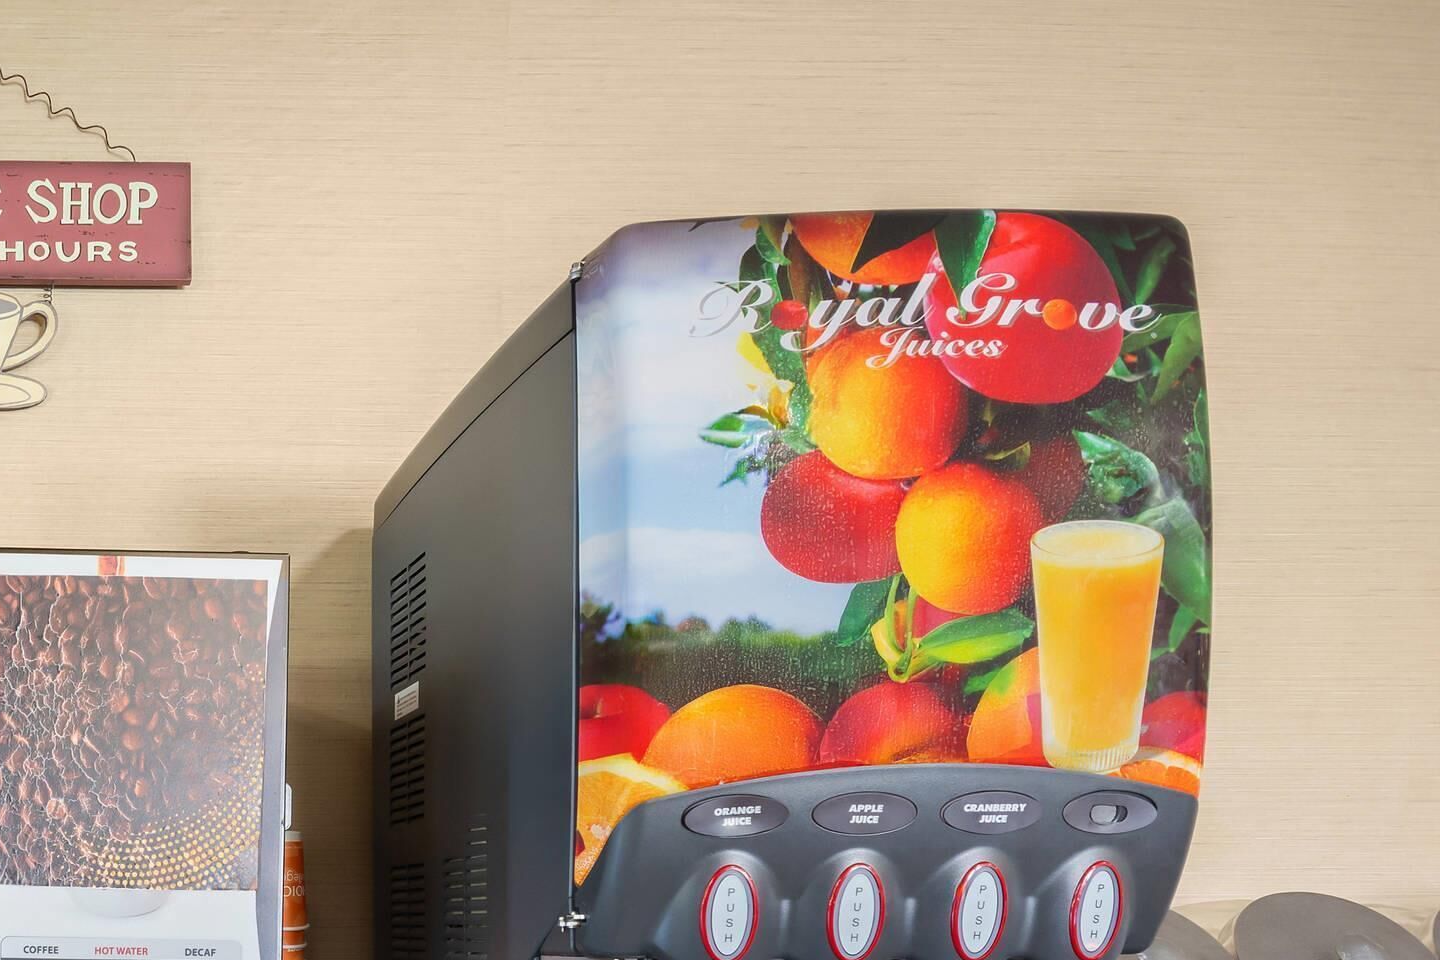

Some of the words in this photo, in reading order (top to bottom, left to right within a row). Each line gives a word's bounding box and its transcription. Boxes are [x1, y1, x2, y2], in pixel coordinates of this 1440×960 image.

[25, 178, 159, 225] SHOP
[866, 325, 1008, 369] Juices
[714, 805, 762, 816] ORANGE
[848, 803, 884, 813] APPLE
[963, 802, 1027, 813] CRANBERRY
[722, 816, 752, 826] JUICE
[849, 815, 880, 824] JUICE
[978, 813, 1009, 824] JUICE
[723, 886, 736, 943] PUSH
[850, 886, 864, 943] PUSH
[973, 883, 988, 940] PUSH
[1090, 882, 1105, 939] PUSH
[23, 945, 59, 954] COFFEE
[94, 946, 114, 955] HOT
[116, 947, 148, 956] WATER
[184, 948, 216, 957] DECAF
